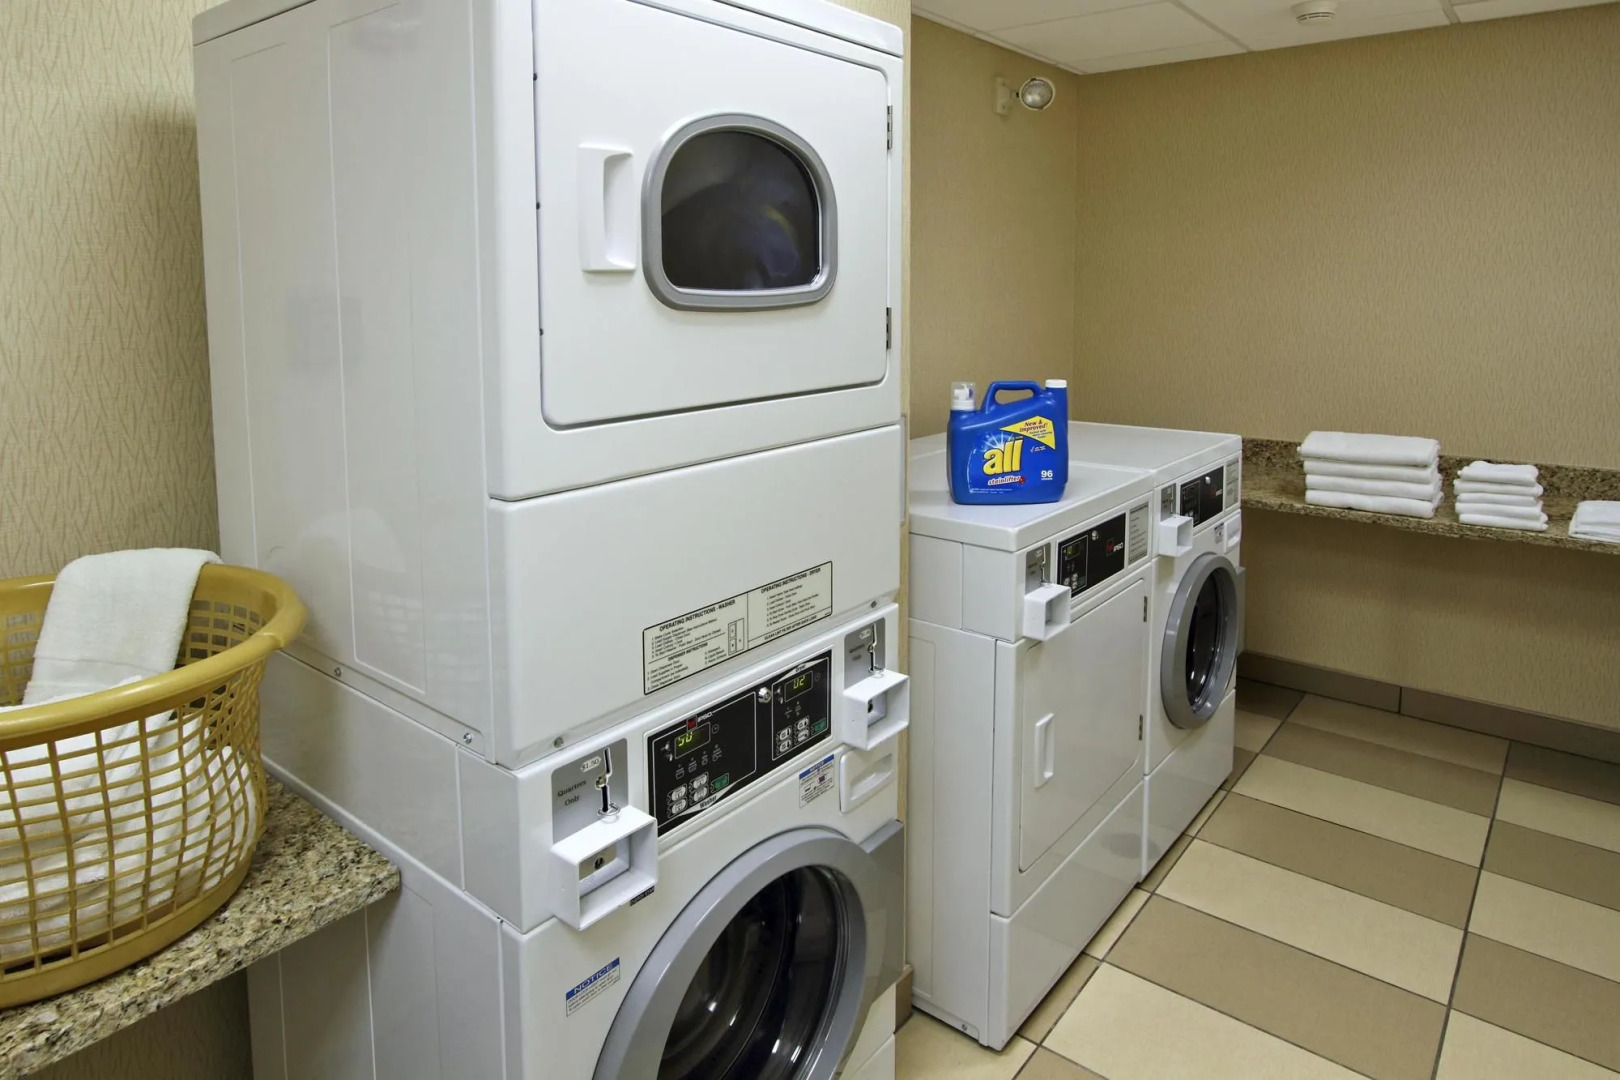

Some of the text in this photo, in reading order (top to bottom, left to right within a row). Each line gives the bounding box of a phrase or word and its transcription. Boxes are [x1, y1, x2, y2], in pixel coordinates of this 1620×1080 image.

[983, 439, 1023, 476] all
[1041, 470, 1053, 478] 96
[761, 581, 782, 594] OPERATING
[782, 572, 808, 587] INSTRUCTIONS
[659, 599, 736, 632] OPERATING INSTRUCTIONS WASHER
[582, 758, 600, 769] $1.50
[558, 780, 587, 797] Quarters
[564, 795, 580, 806] Only
[574, 963, 613, 994] NOTICE
